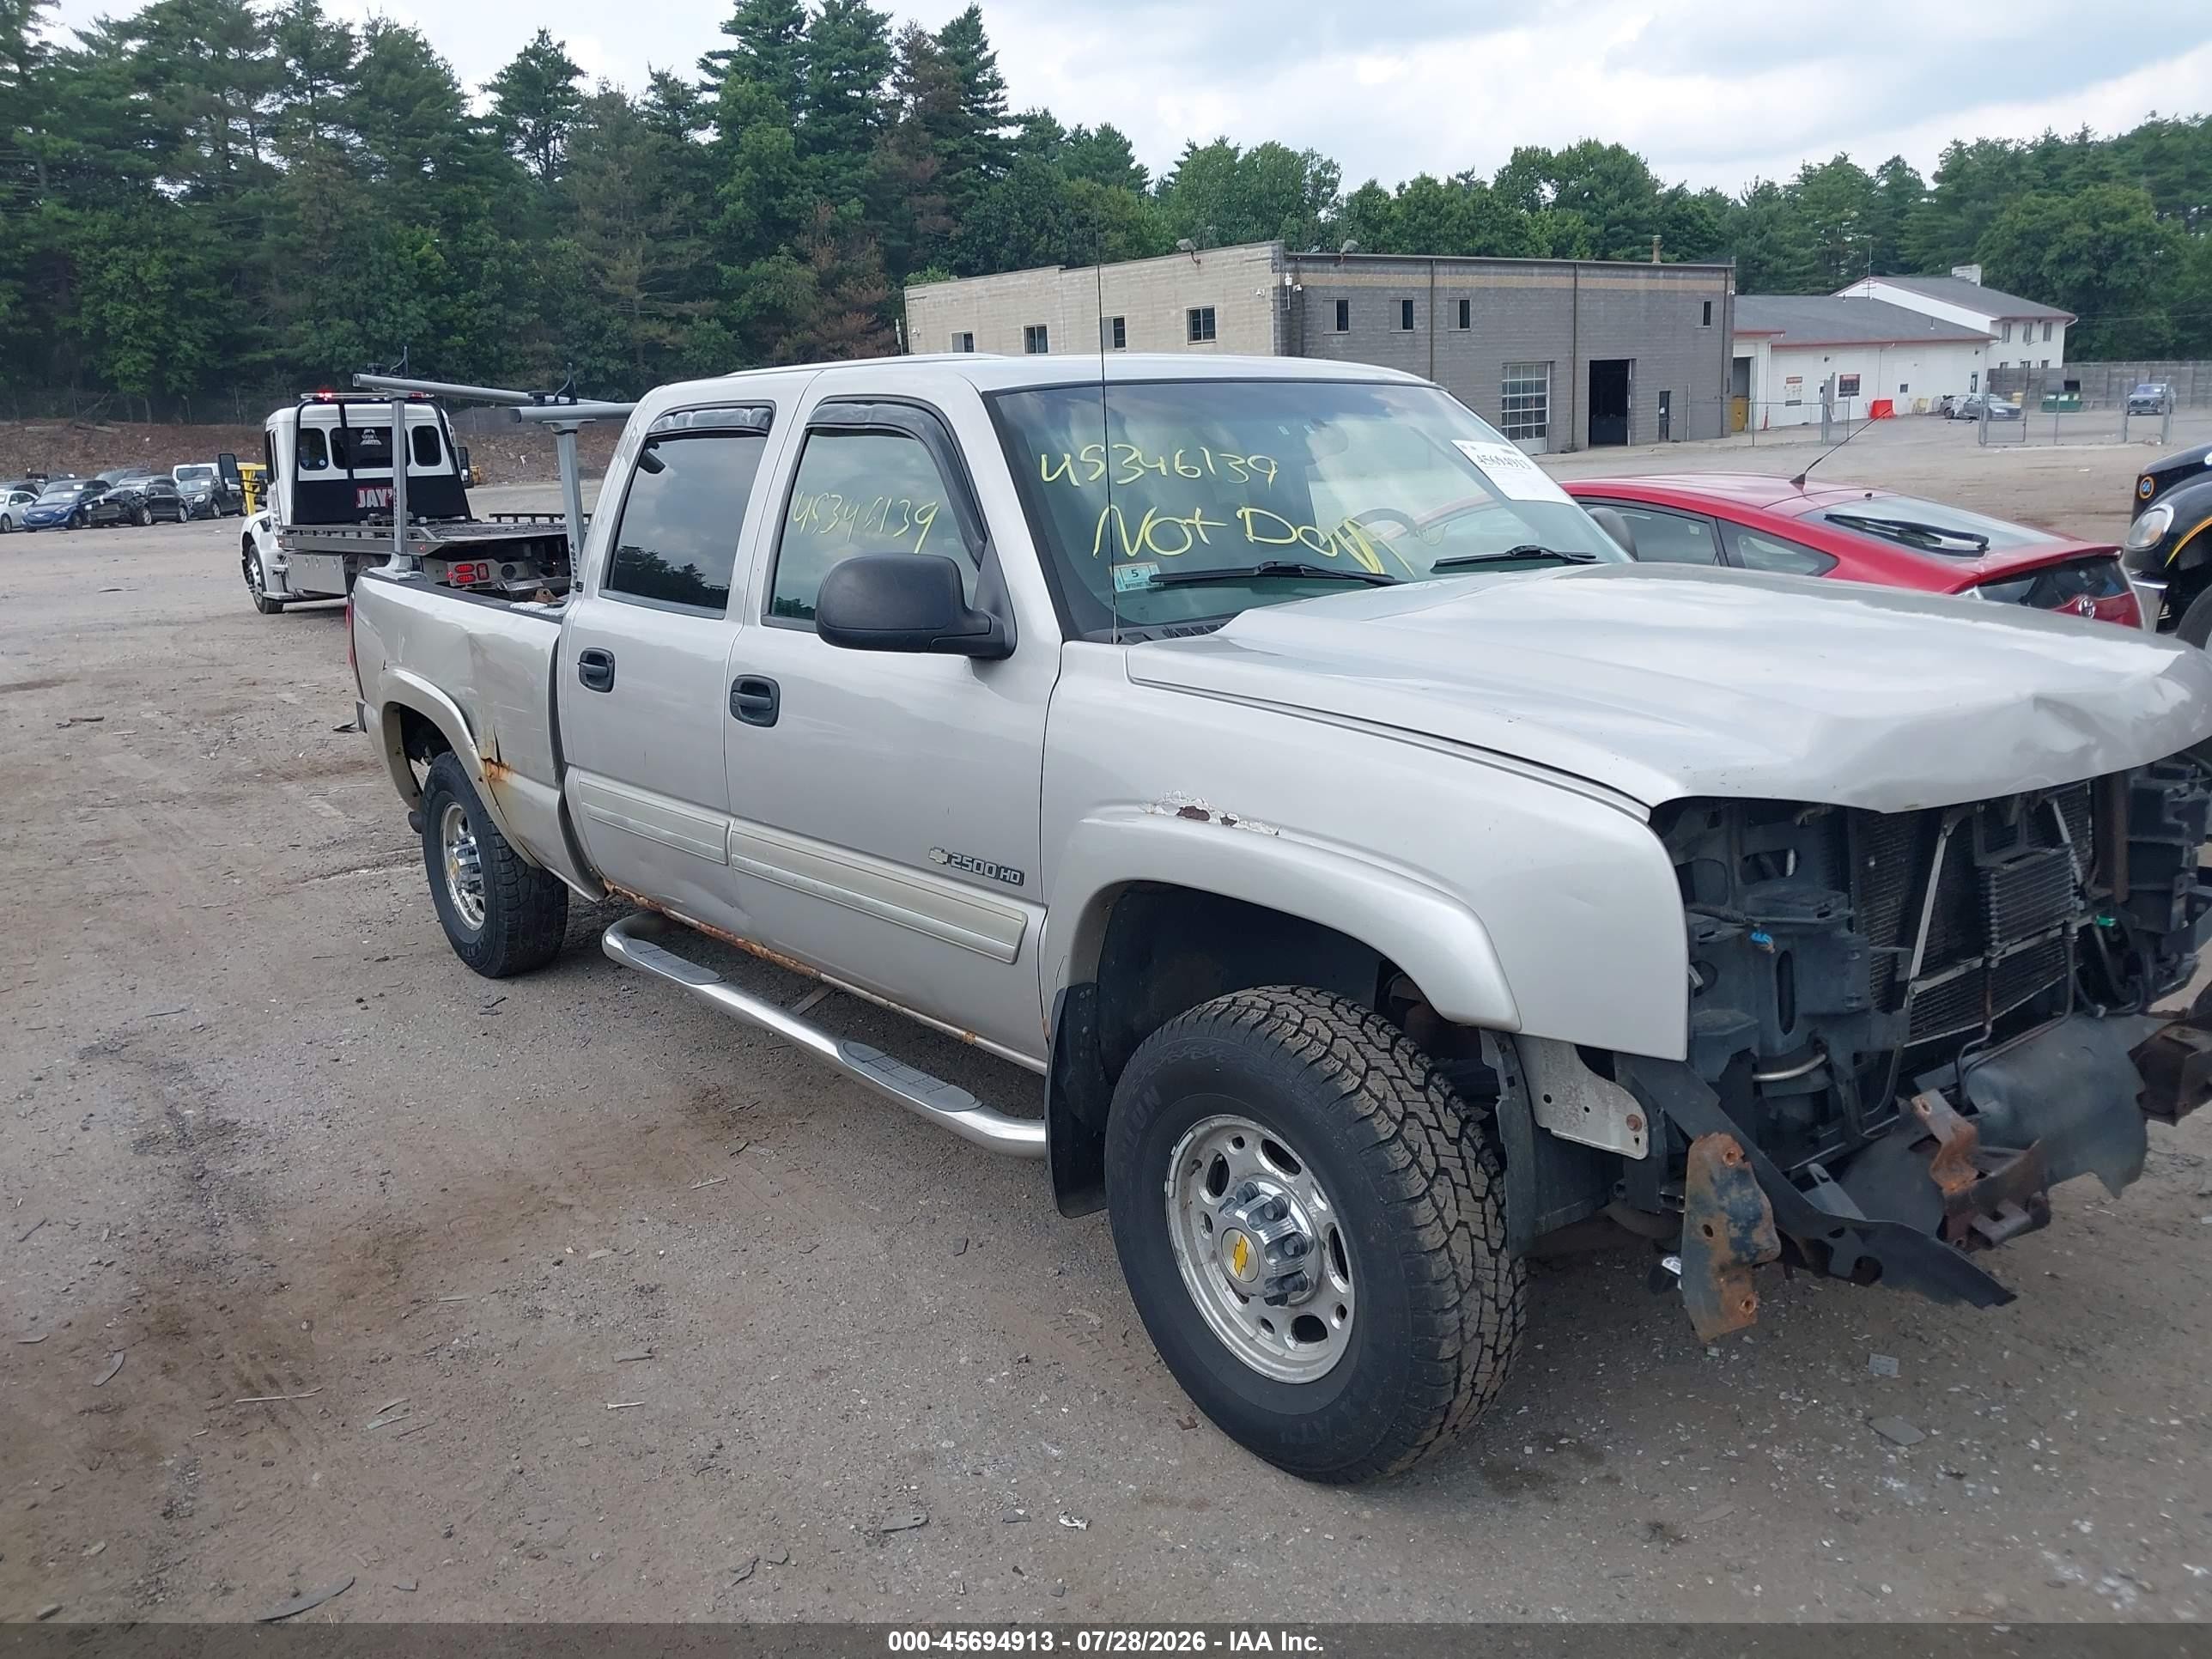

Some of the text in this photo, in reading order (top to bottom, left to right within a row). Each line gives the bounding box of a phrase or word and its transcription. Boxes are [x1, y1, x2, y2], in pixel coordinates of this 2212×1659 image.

[356, 488, 392, 508] JAY'
[1093, 505, 1228, 558] Not
[1131, 568, 1139, 578] 5
[951, 853, 1022, 885] 2500 HD
